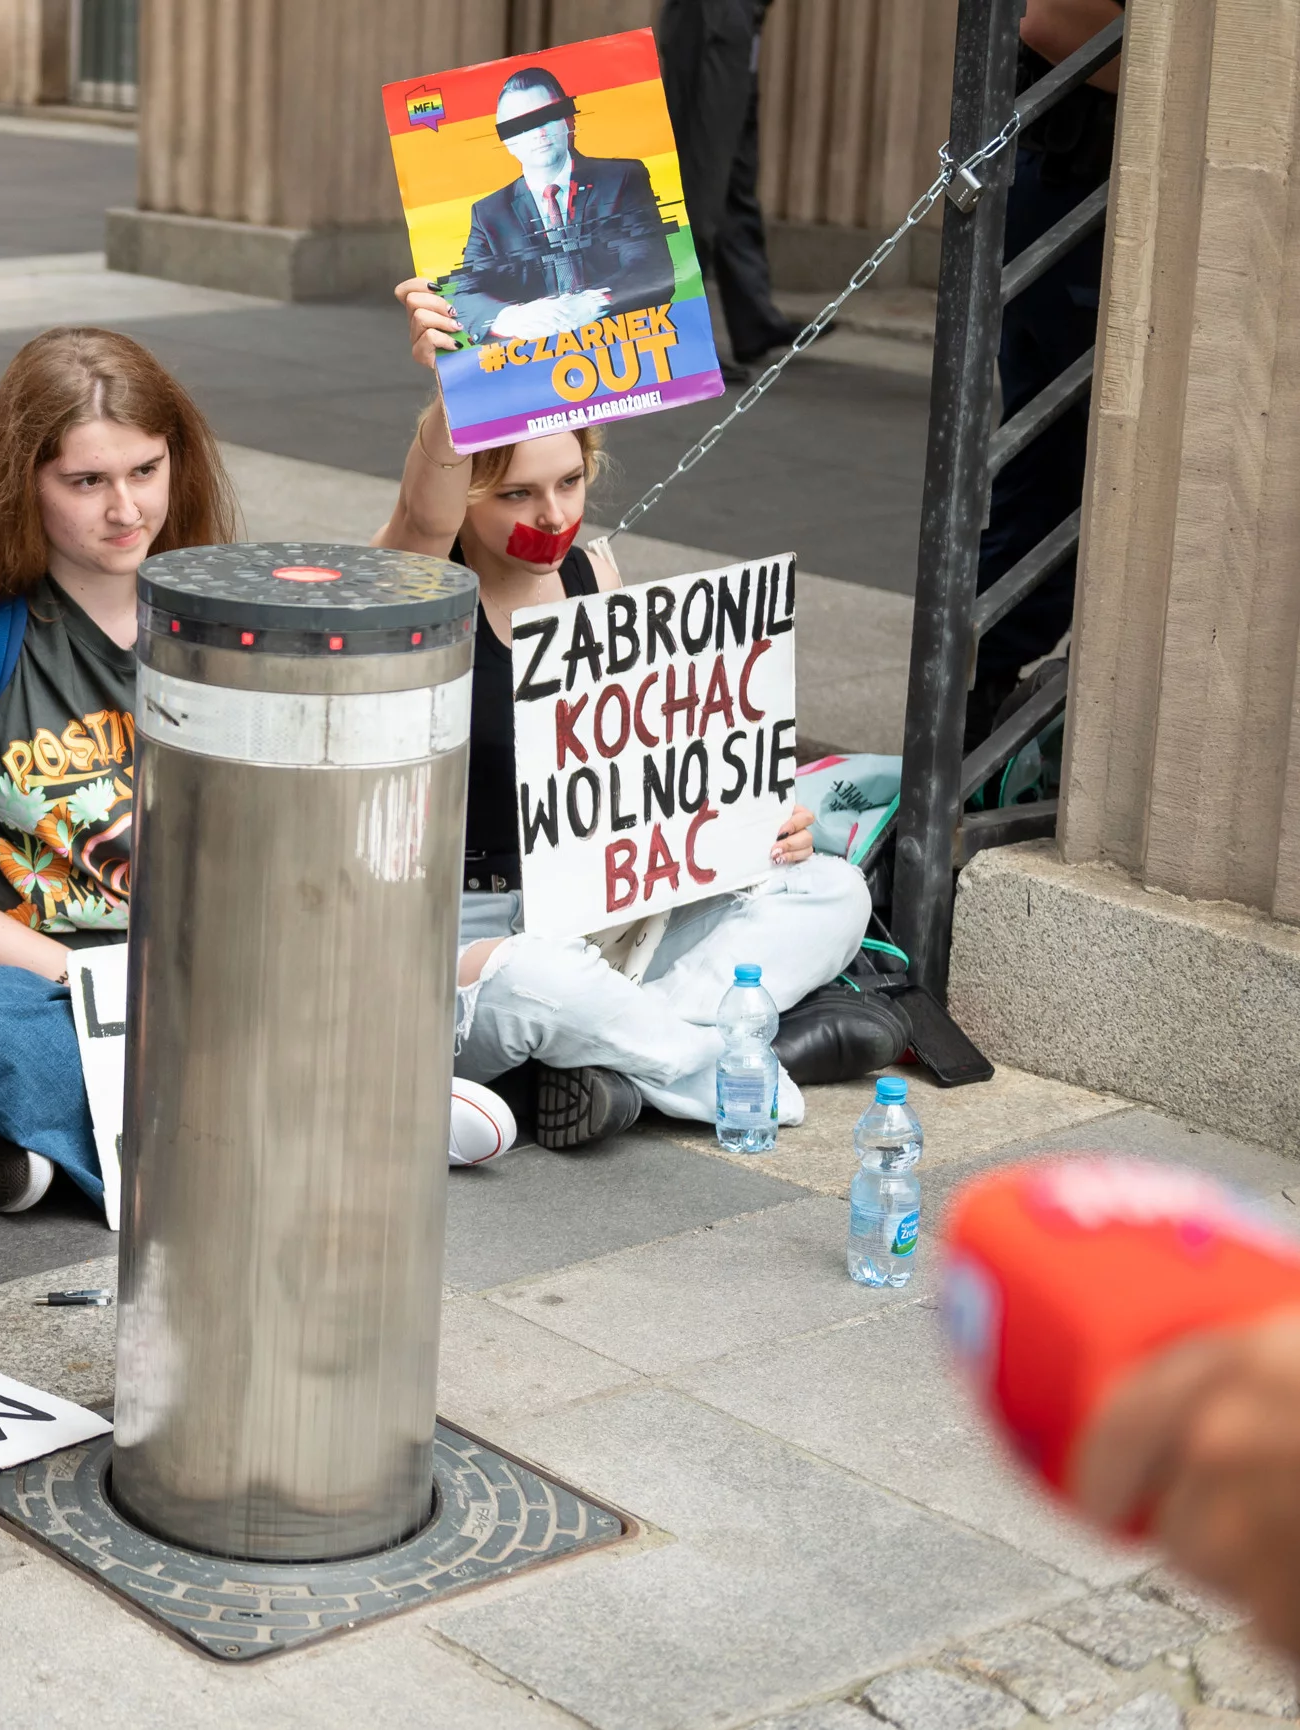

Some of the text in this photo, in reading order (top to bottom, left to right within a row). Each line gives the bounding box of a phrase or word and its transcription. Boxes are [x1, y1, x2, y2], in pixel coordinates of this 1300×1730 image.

[413, 101, 440, 114] MFL
[477, 303, 678, 373] #CZARNEK
[551, 331, 680, 402] OUT
[526, 389, 663, 434] DZIECI SĄ ZAGROŻONE!
[513, 556, 796, 701] ZABRONILI
[555, 626, 773, 771] KOCHAĆ
[520, 718, 796, 856] WOLNO SIĘ
[605, 798, 719, 913] BAĆ
